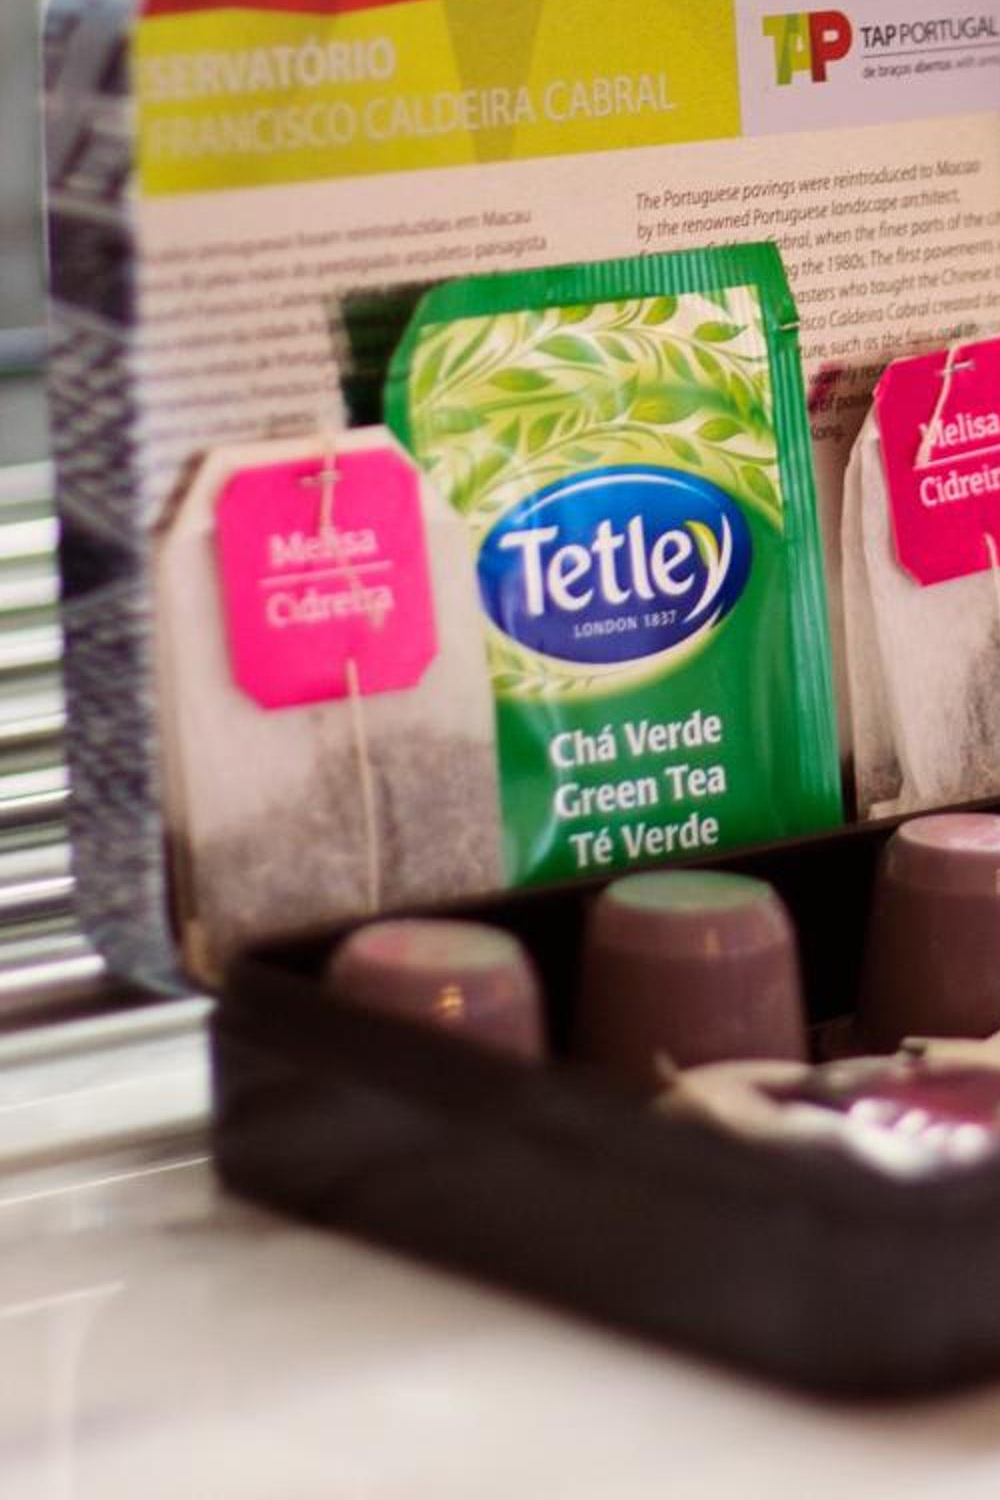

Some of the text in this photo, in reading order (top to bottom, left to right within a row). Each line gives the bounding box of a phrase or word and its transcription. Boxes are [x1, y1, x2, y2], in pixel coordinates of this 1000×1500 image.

[762, 10, 853, 86] TAP
[860, 16, 1000, 48] TAP PORTUGAL
[364, 84, 534, 140] CALDEIRA
[542, 72, 677, 122] CABRAL
[635, 191, 660, 210] The
[663, 184, 740, 209] Portuguese
[741, 179, 796, 201] pavings
[798, 175, 831, 192] were
[833, 163, 917, 188] reintroduced
[919, 164, 932, 181] to
[482, 210, 533, 227] Macau
[636, 222, 653, 244] by
[656, 218, 679, 236] the
[681, 211, 751, 234] renowned
[752, 202, 829, 227] Portuguese
[830, 197, 898, 218] landscape
[815, 227, 852, 246] when
[854, 223, 876, 243] the
[911, 217, 945, 237] parts
[947, 211, 961, 231] of
[963, 210, 984, 229] the
[801, 257, 824, 277] the
[870, 247, 895, 268] The
[797, 285, 836, 304] asters
[838, 279, 871, 299] who
[916, 273, 940, 292] the
[885, 296, 930, 320] Cabral
[830, 333, 861, 353] such
[863, 334, 880, 350] as
[881, 328, 903, 348] the
[498, 511, 733, 624] Tetley
[573, 608, 678, 640] LONDON 1837
[550, 710, 723, 769] Chá Verde
[554, 763, 727, 820] Green Tea
[568, 813, 720, 869] Té Verde
